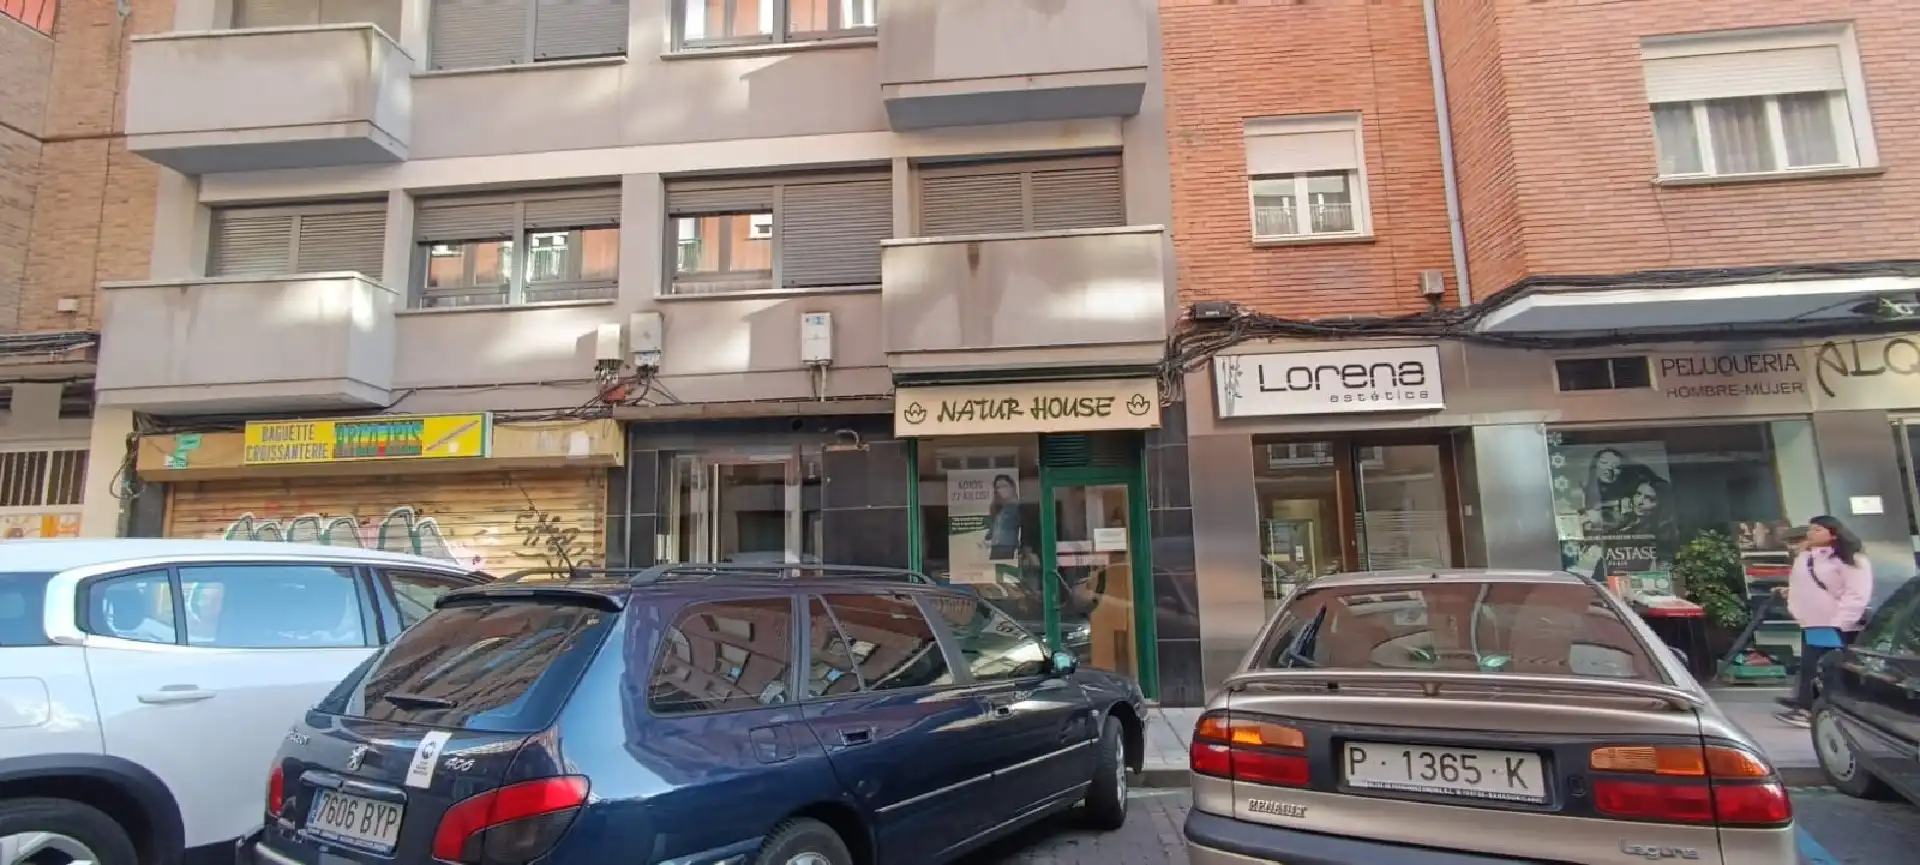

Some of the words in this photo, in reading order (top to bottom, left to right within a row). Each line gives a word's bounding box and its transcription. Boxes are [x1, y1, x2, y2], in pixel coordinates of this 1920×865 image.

[1258, 360, 1425, 392] Lorena
[1661, 353, 1800, 378] PELUQUERIA
[1330, 390, 1429, 403] estética
[1666, 382, 1805, 398] HOMBRE-MUJER
[937, 397, 1024, 423] NATUR
[1030, 396, 1115, 420] HOUSE
[262, 424, 315, 442] BAGUETTE
[245, 443, 329, 462] CROISSANTERIE
[1350, 746, 1367, 776] P
[1402, 750, 1482, 785] 1365
[1505, 756, 1529, 789] K
[317, 792, 359, 830] 7606
[360, 802, 397, 839] BYP
